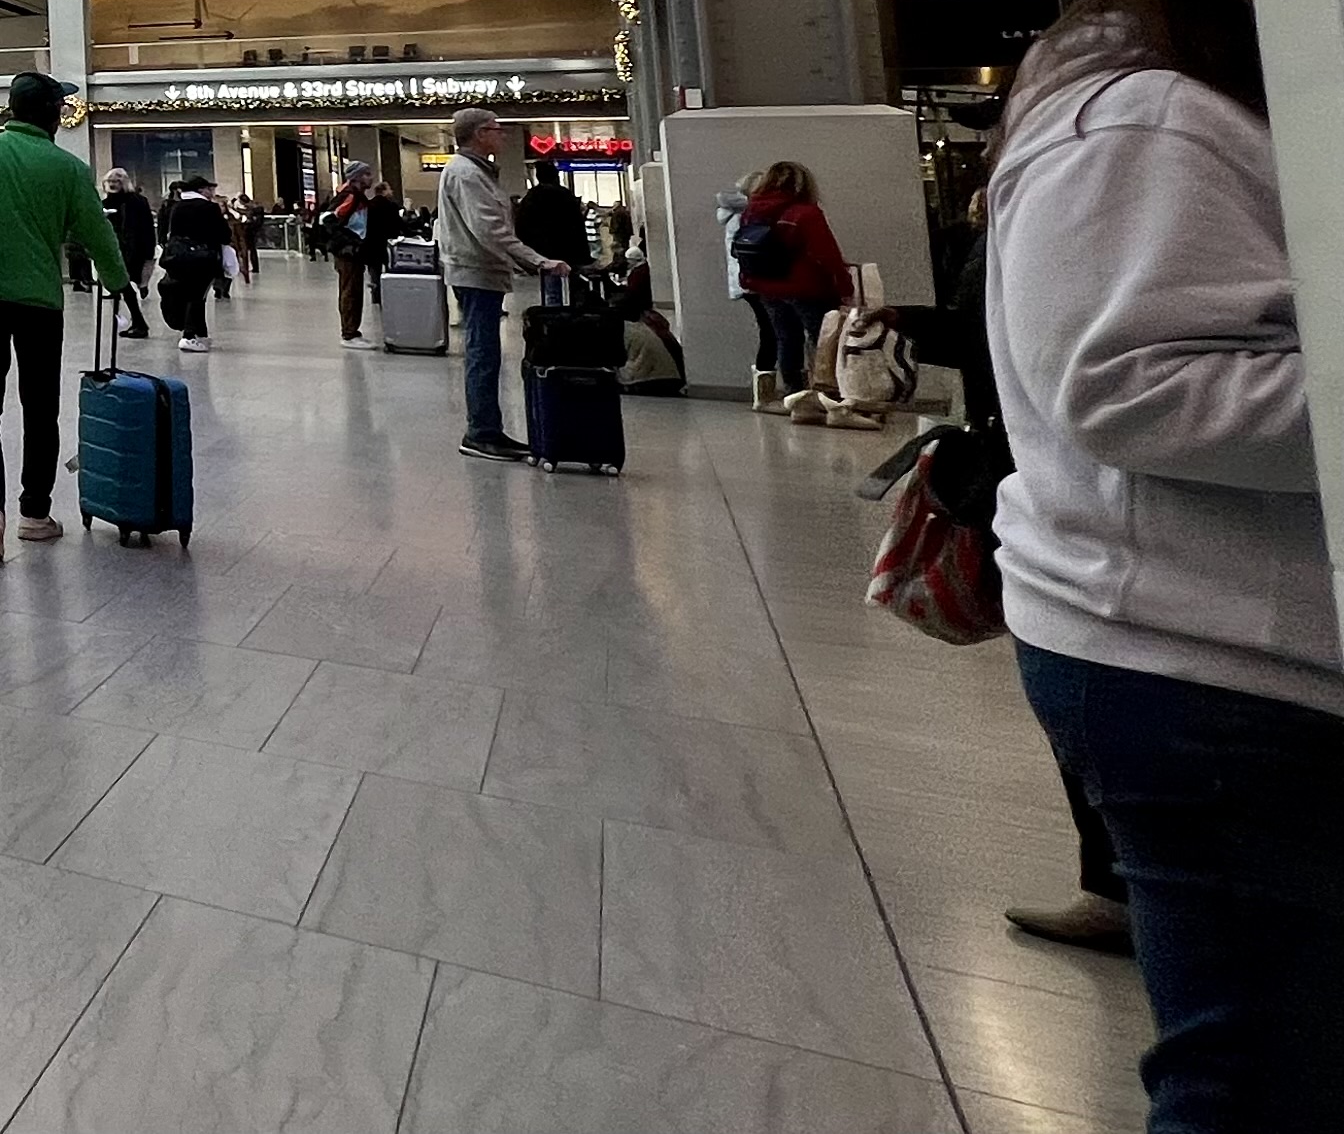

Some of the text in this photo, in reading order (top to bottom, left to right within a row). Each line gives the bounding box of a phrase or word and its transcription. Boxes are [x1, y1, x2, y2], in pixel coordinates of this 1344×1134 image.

[217, 83, 280, 99] Avenue
[283, 81, 299, 98] &
[301, 80, 343, 98] 33rd
[345, 79, 406, 98] Street
[422, 77, 498, 98] Subway
